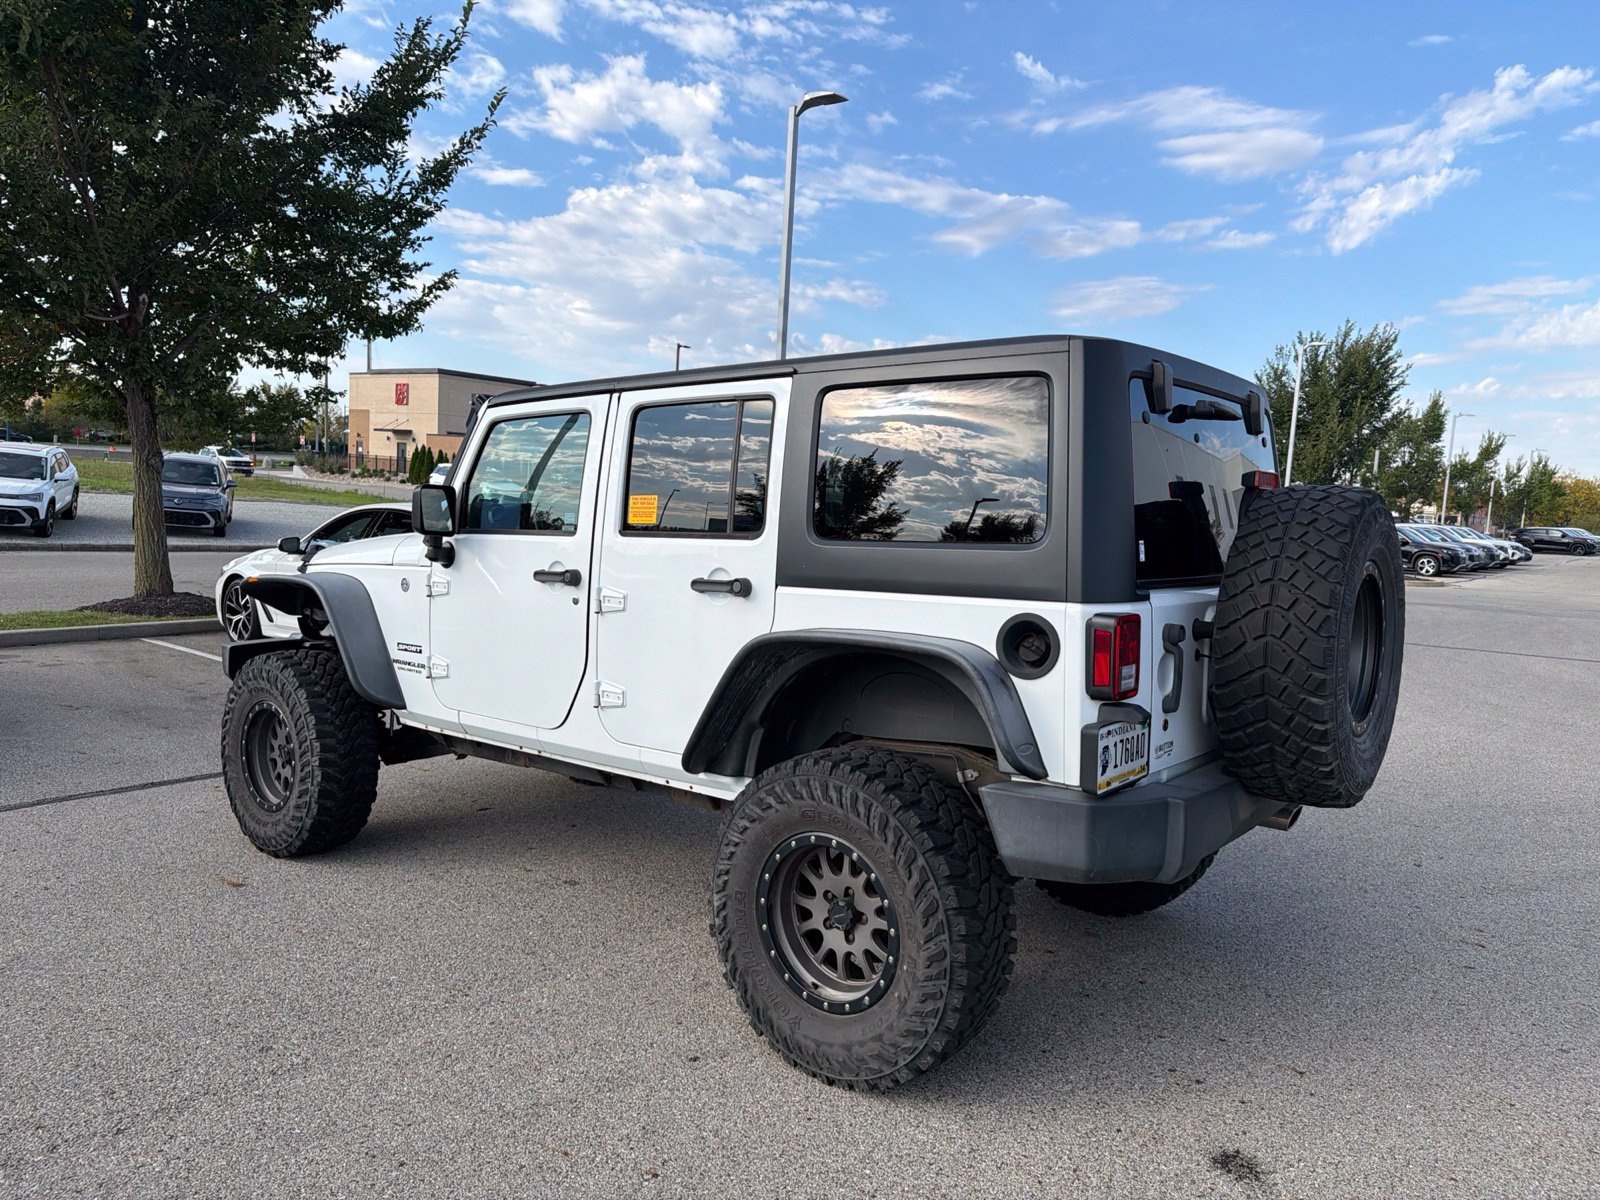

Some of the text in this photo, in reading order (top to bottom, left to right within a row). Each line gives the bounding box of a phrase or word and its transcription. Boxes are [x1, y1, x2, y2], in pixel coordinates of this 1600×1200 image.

[397, 642, 422, 653] SPORT
[392, 659, 426, 669] WRANGLER
[1111, 724, 1136, 737] INDIANA
